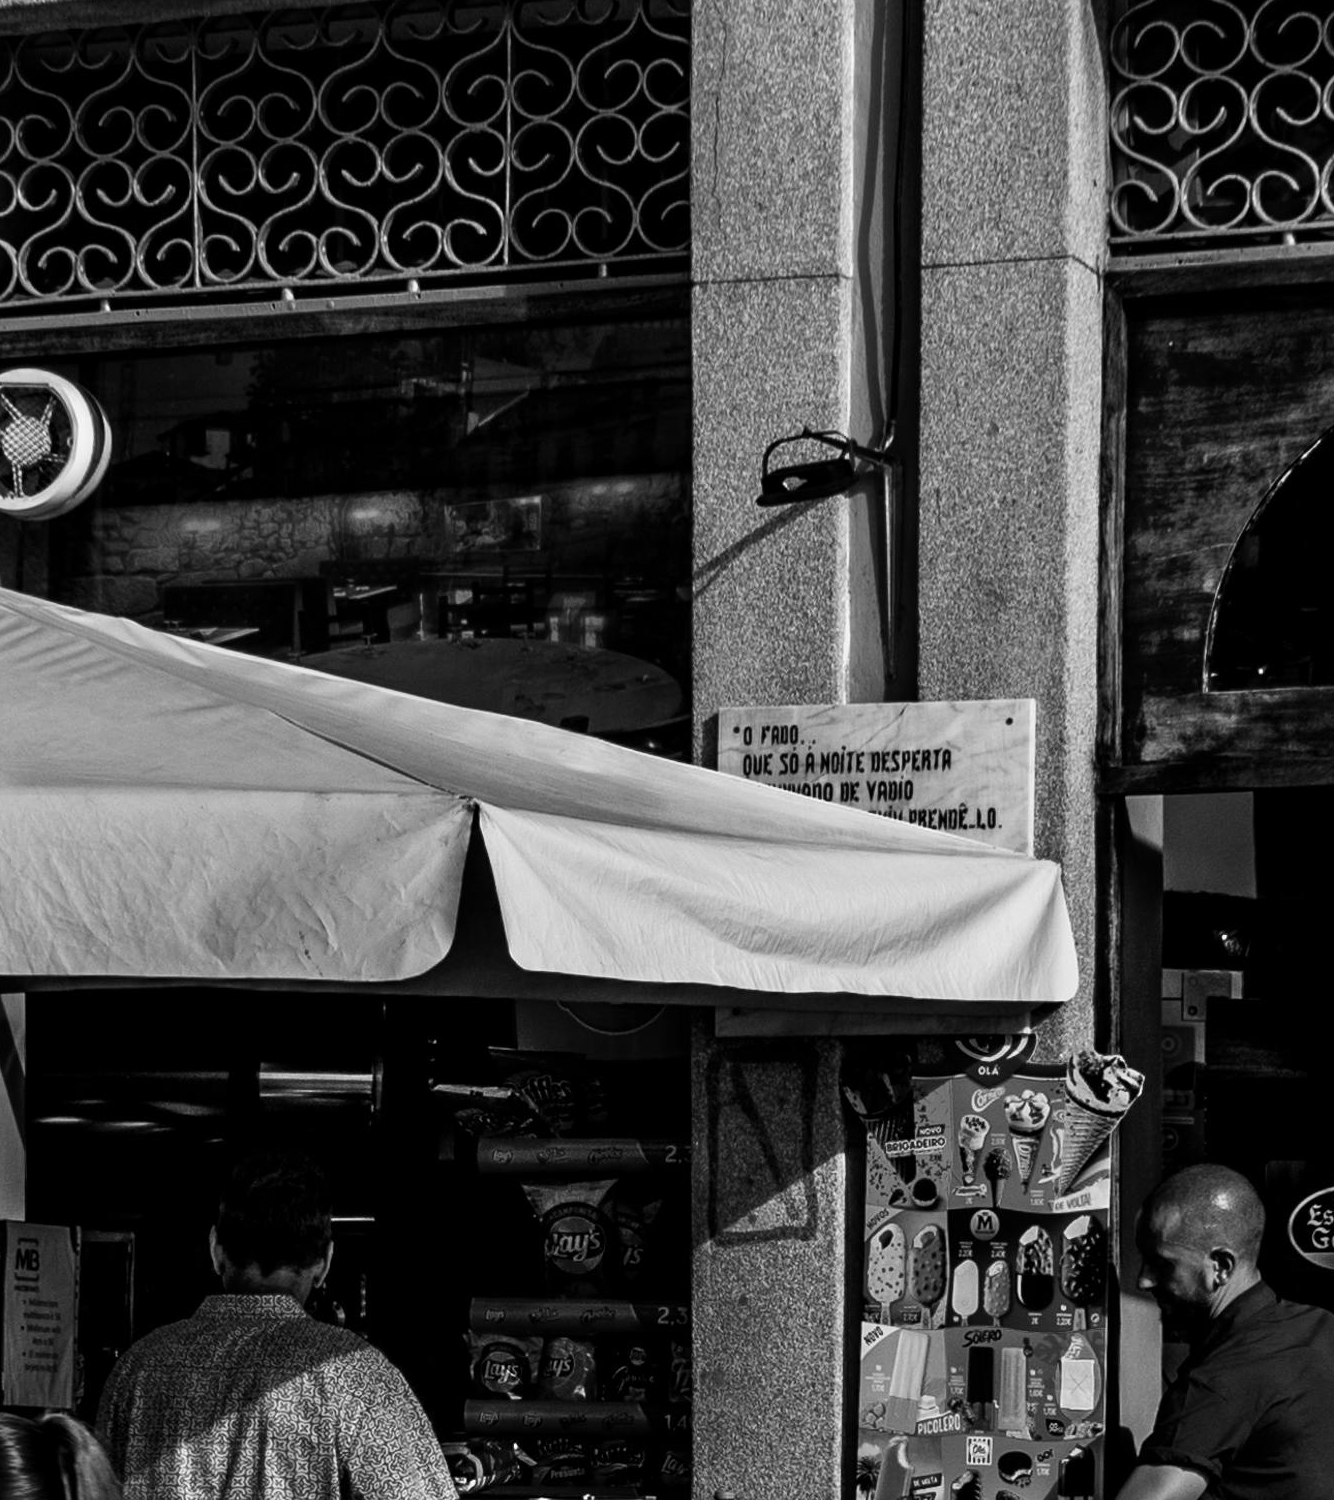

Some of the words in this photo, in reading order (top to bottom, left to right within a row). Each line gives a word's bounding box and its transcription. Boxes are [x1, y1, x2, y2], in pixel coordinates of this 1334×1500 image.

[743, 726, 753, 746] O
[742, 753, 774, 779] QUE
[870, 748, 953, 773] DESPERTA
[840, 780, 860, 803] DE
[978, 1064, 1000, 1076] OLÁ
[919, 1126, 942, 1135] NOVO
[886, 1136, 946, 1152] BRIGADEIRO
[866, 1208, 890, 1230] NOVOS
[15, 1248, 40, 1271] MB
[863, 1326, 884, 1346] NOVO
[963, 1329, 1003, 1347] SOLERO
[918, 1413, 961, 1436] PICOLERO
